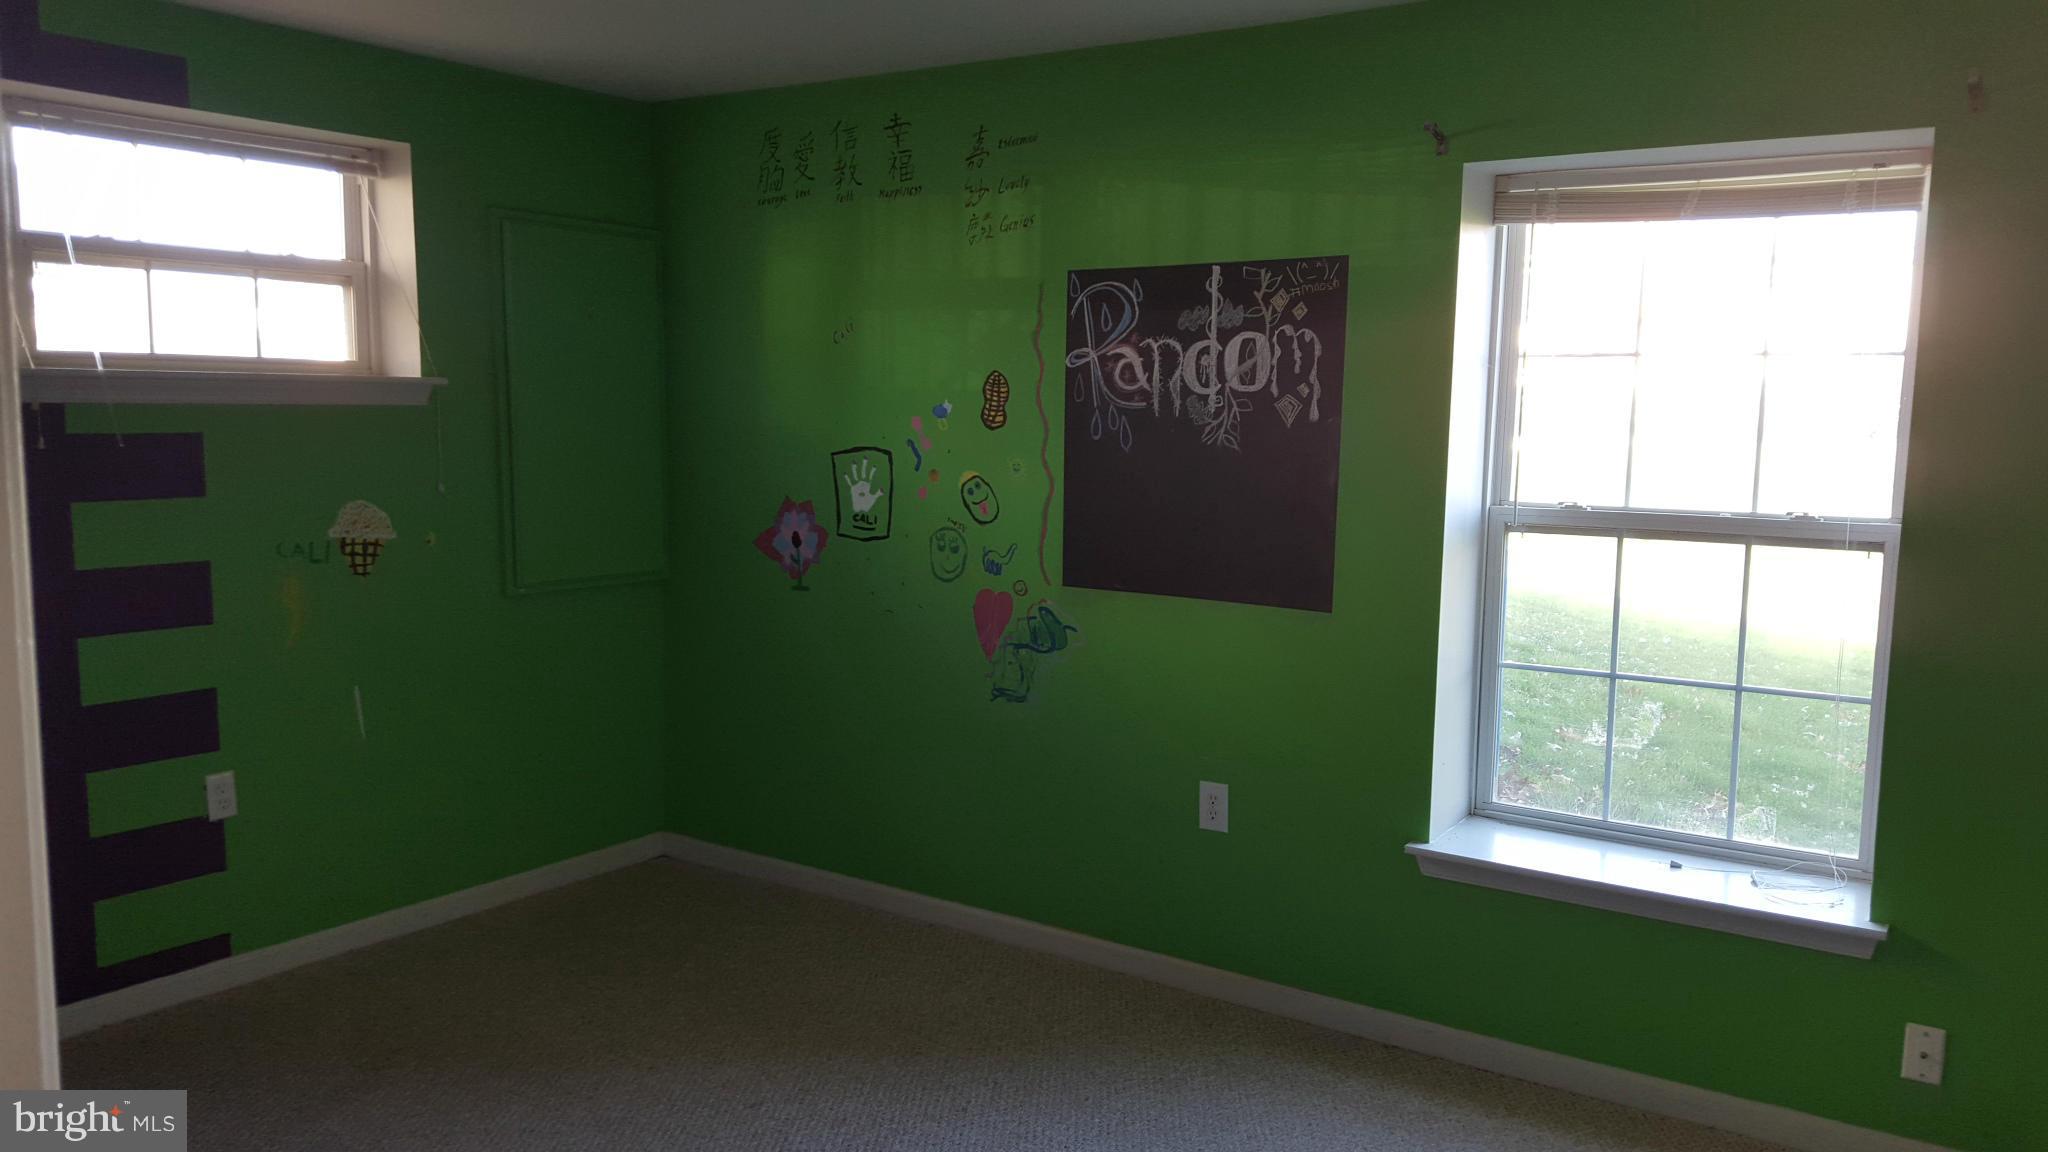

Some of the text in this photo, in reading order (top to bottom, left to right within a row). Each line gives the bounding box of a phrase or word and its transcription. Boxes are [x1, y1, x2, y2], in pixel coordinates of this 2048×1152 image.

[1066, 265, 1322, 421] Random
[852, 512, 877, 525] CALI
[275, 540, 330, 564] CALI
